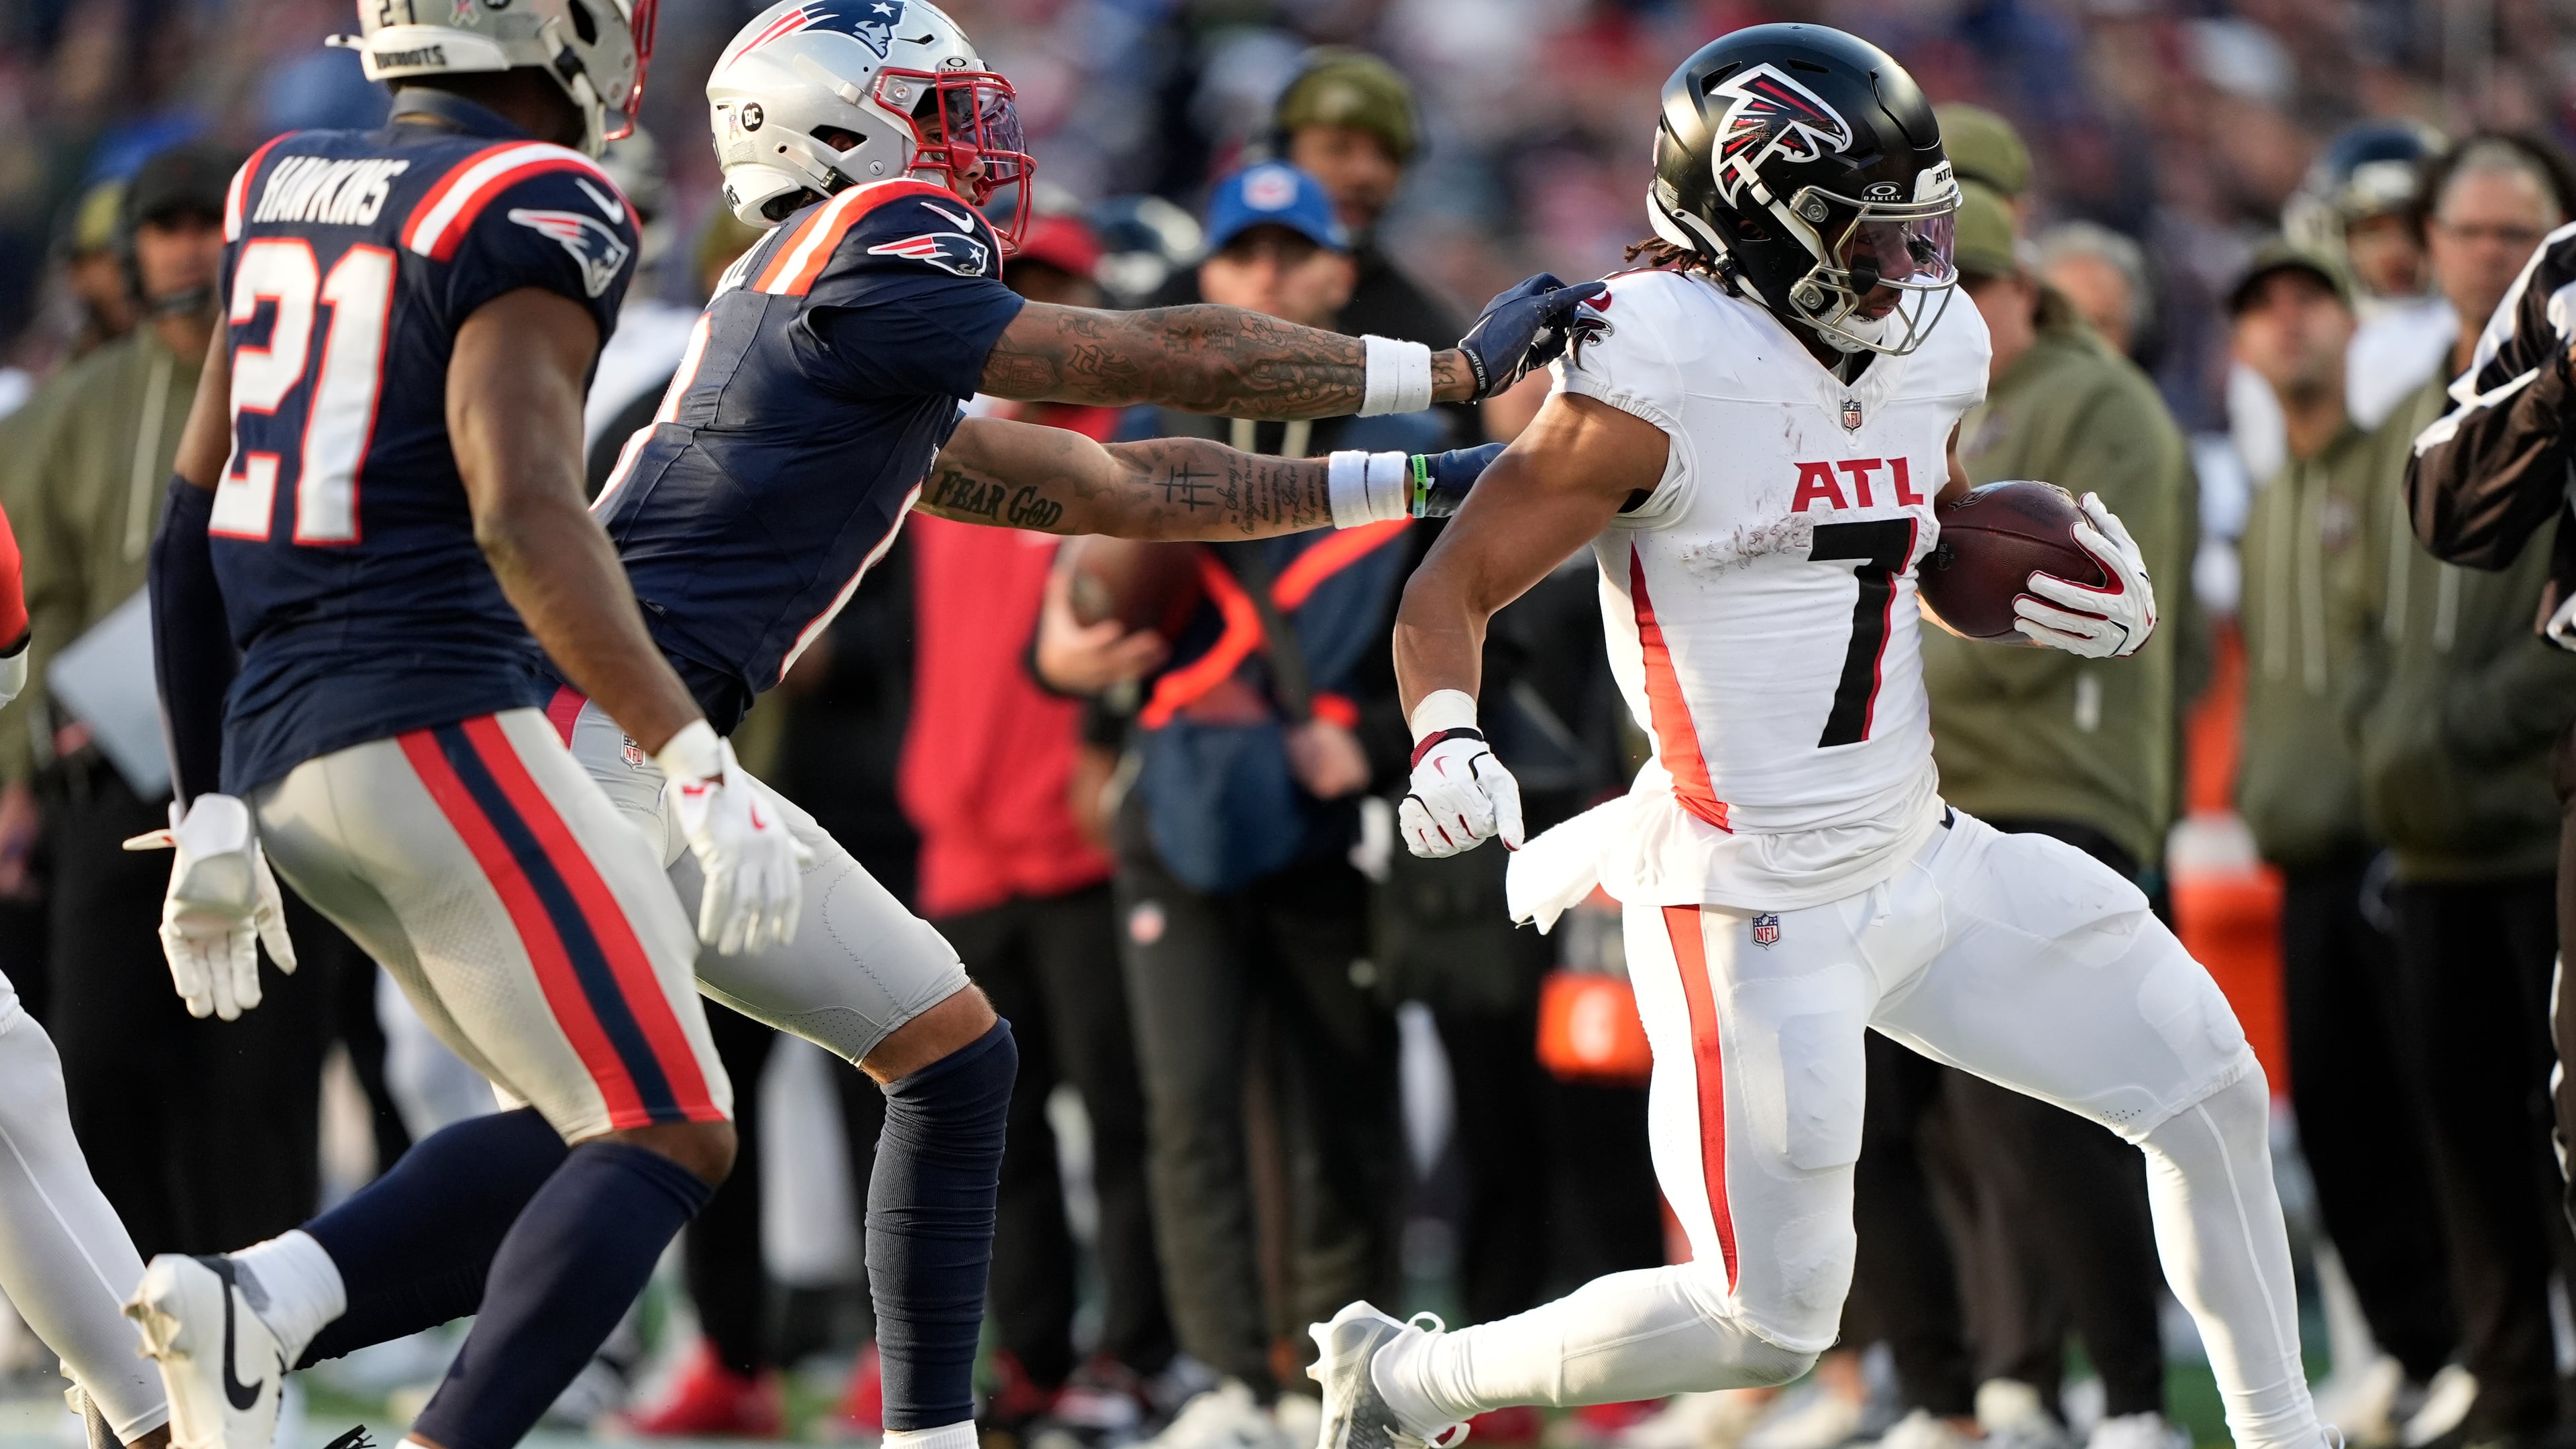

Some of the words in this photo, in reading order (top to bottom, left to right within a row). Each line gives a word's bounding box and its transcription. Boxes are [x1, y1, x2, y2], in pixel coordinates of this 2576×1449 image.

[744, 107, 761, 127] BC
[1935, 168, 1951, 184] ATL
[252, 156, 410, 226] HAWKINS
[1477, 366, 1487, 390] CULTURE
[208, 237, 397, 546] 21
[1844, 413, 1860, 427] NFL
[931, 470, 1006, 521] FEAR
[1791, 457, 1924, 513] ATL
[1807, 517, 1918, 749] 7
[626, 747, 642, 762] NFL
[1756, 927, 1777, 942] NFL
